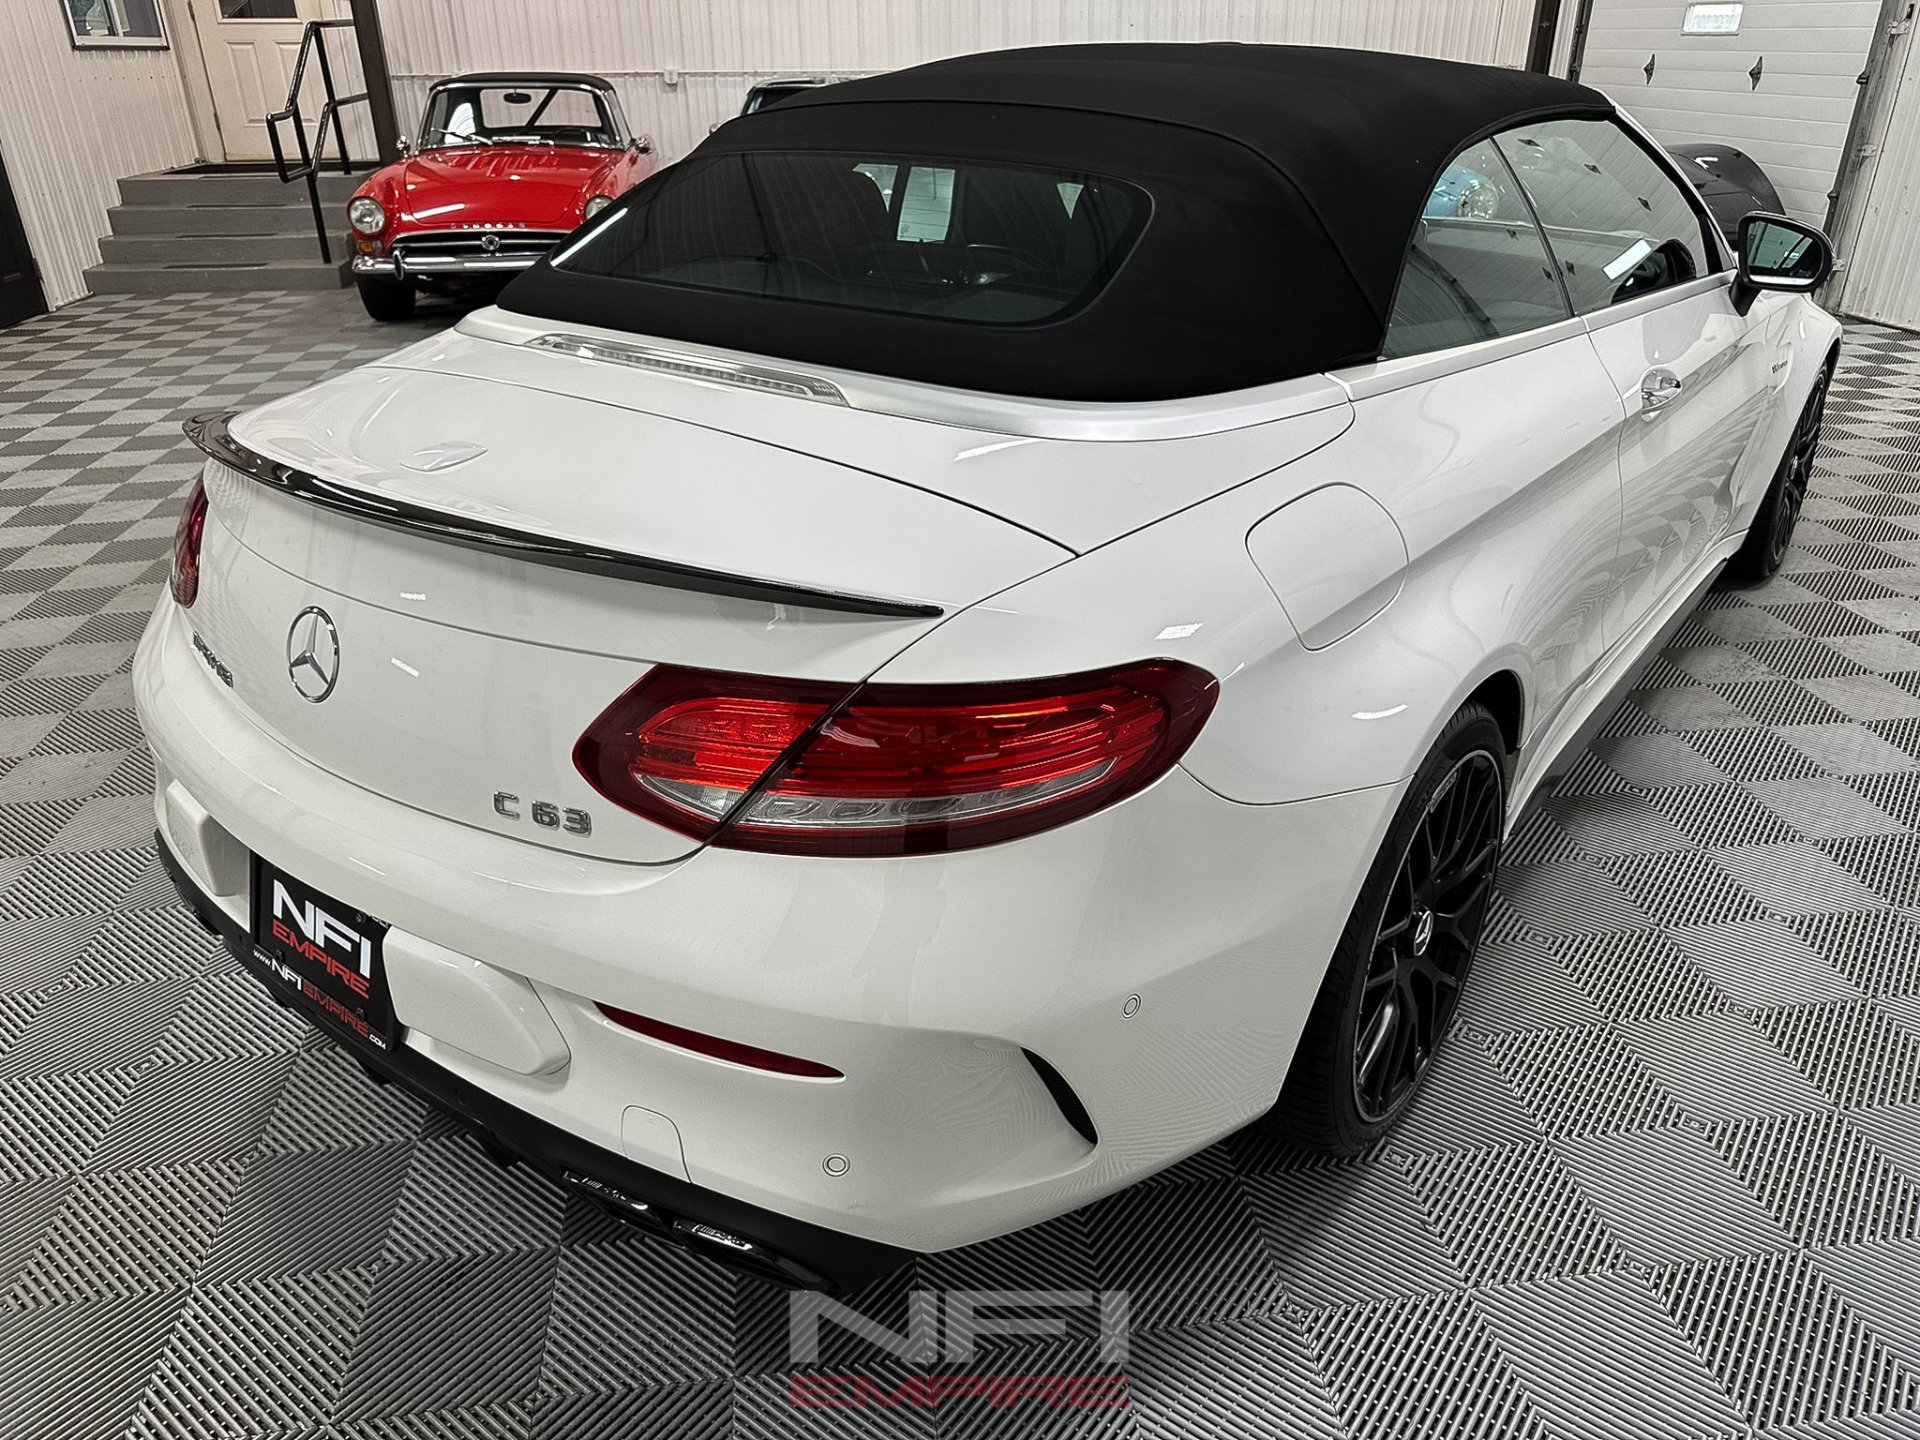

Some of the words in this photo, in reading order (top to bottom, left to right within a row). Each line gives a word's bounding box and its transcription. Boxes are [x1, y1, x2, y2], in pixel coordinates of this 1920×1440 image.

[493, 790, 520, 820] C
[531, 800, 592, 837] 63
[273, 878, 372, 979] NFI
[273, 919, 369, 999] EMPIRE
